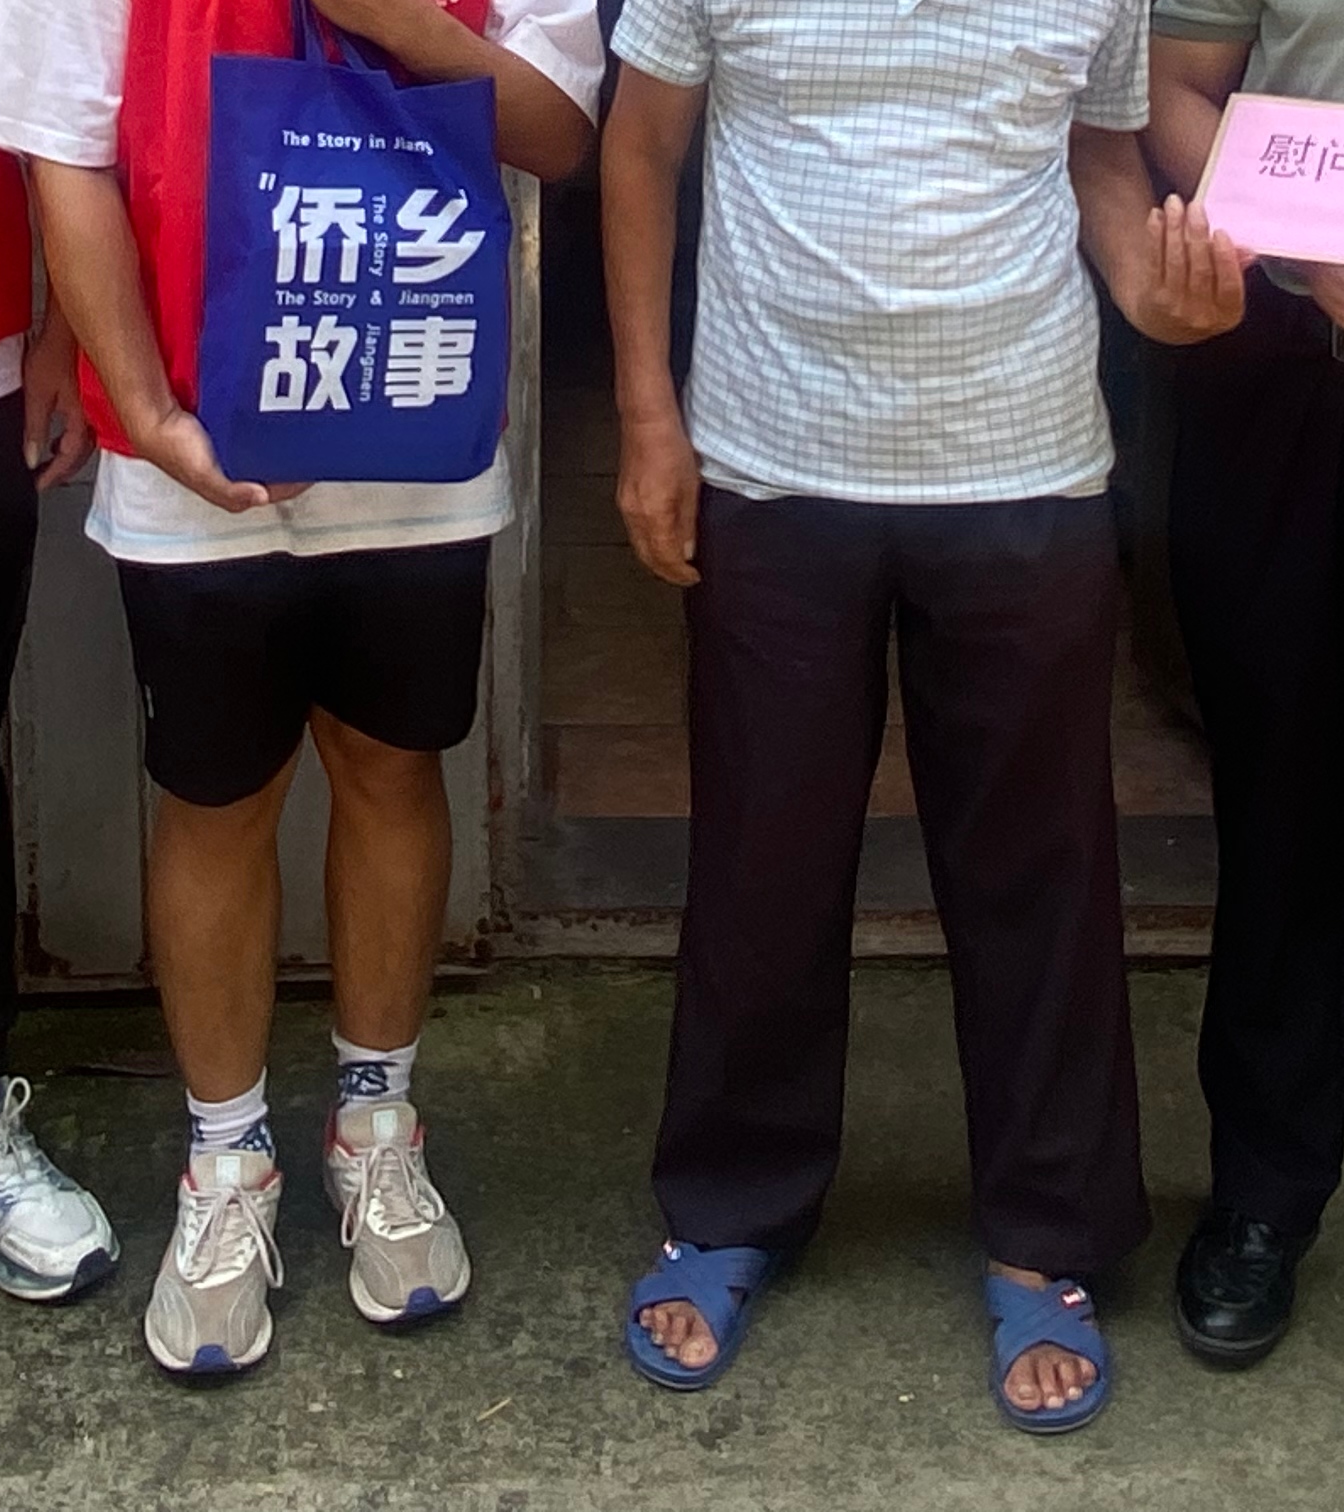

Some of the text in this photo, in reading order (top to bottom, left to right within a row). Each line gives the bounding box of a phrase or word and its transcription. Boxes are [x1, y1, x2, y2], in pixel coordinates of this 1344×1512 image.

[282, 130, 310, 147] The
[317, 132, 361, 152] Story
[369, 133, 386, 150] in
[369, 194, 388, 276] The Story
[275, 290, 474, 308] The Story & Jiangmen
[259, 315, 477, 412] 故事
[360, 323, 381, 402] Jiangmen
